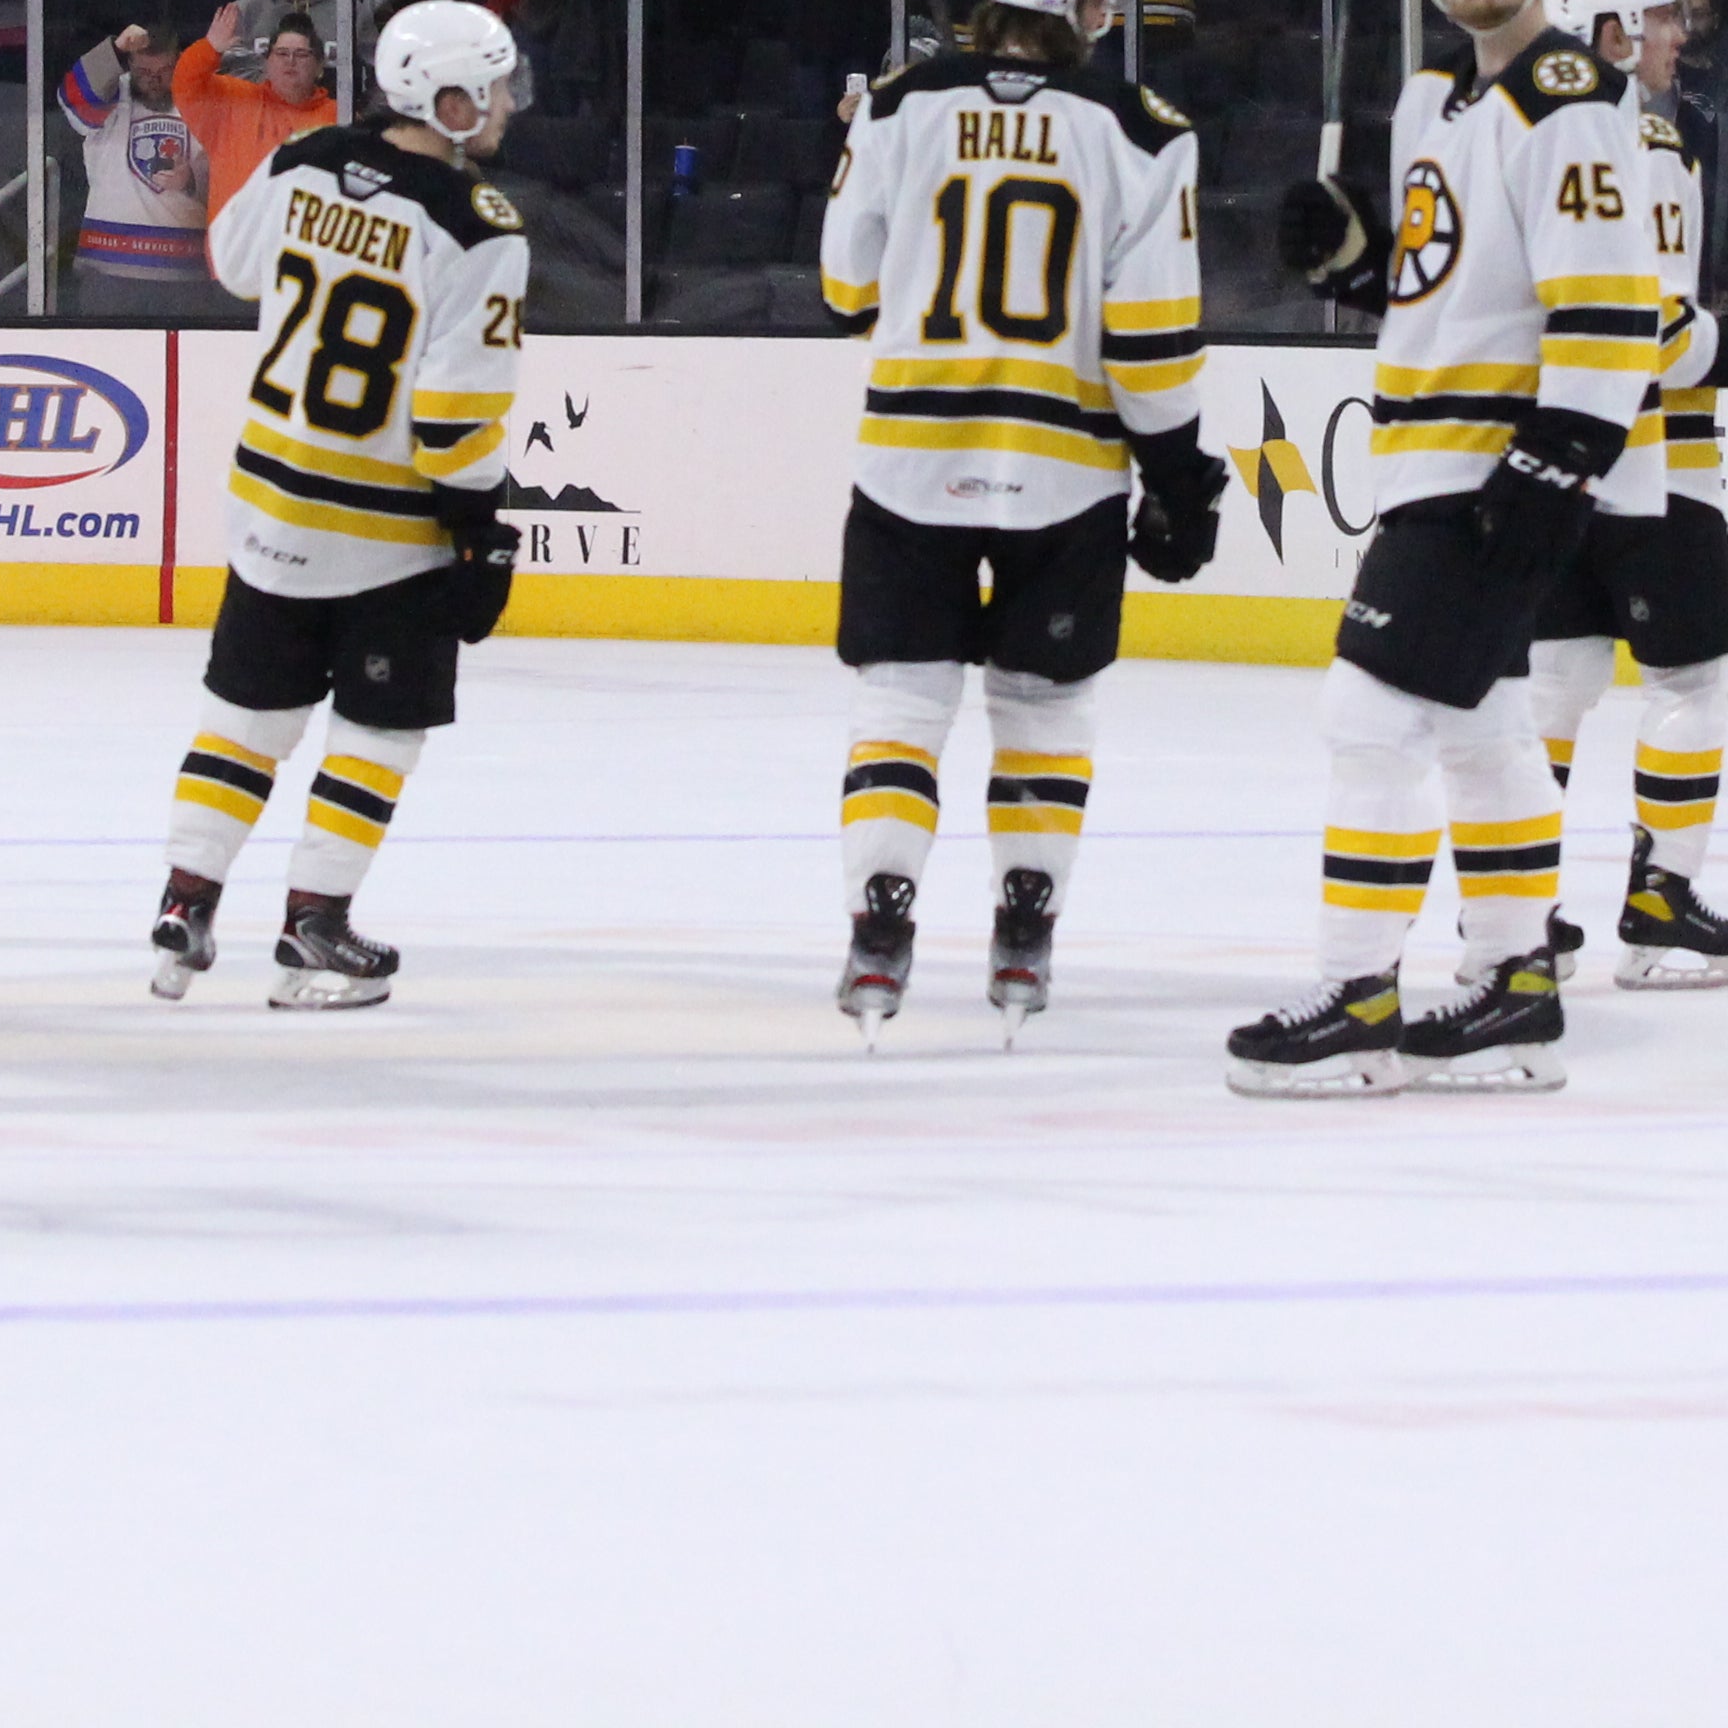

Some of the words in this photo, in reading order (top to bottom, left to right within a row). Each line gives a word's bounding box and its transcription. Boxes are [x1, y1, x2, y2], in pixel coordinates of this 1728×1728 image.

[131, 120, 186, 137] P-BRUINS
[956, 109, 1060, 167] HALL
[1556, 162, 1626, 222] 45
[283, 187, 413, 273] FRODEN
[1651, 200, 1686, 255] 17
[920, 174, 1082, 347] 10
[248, 248, 419, 441] 28
